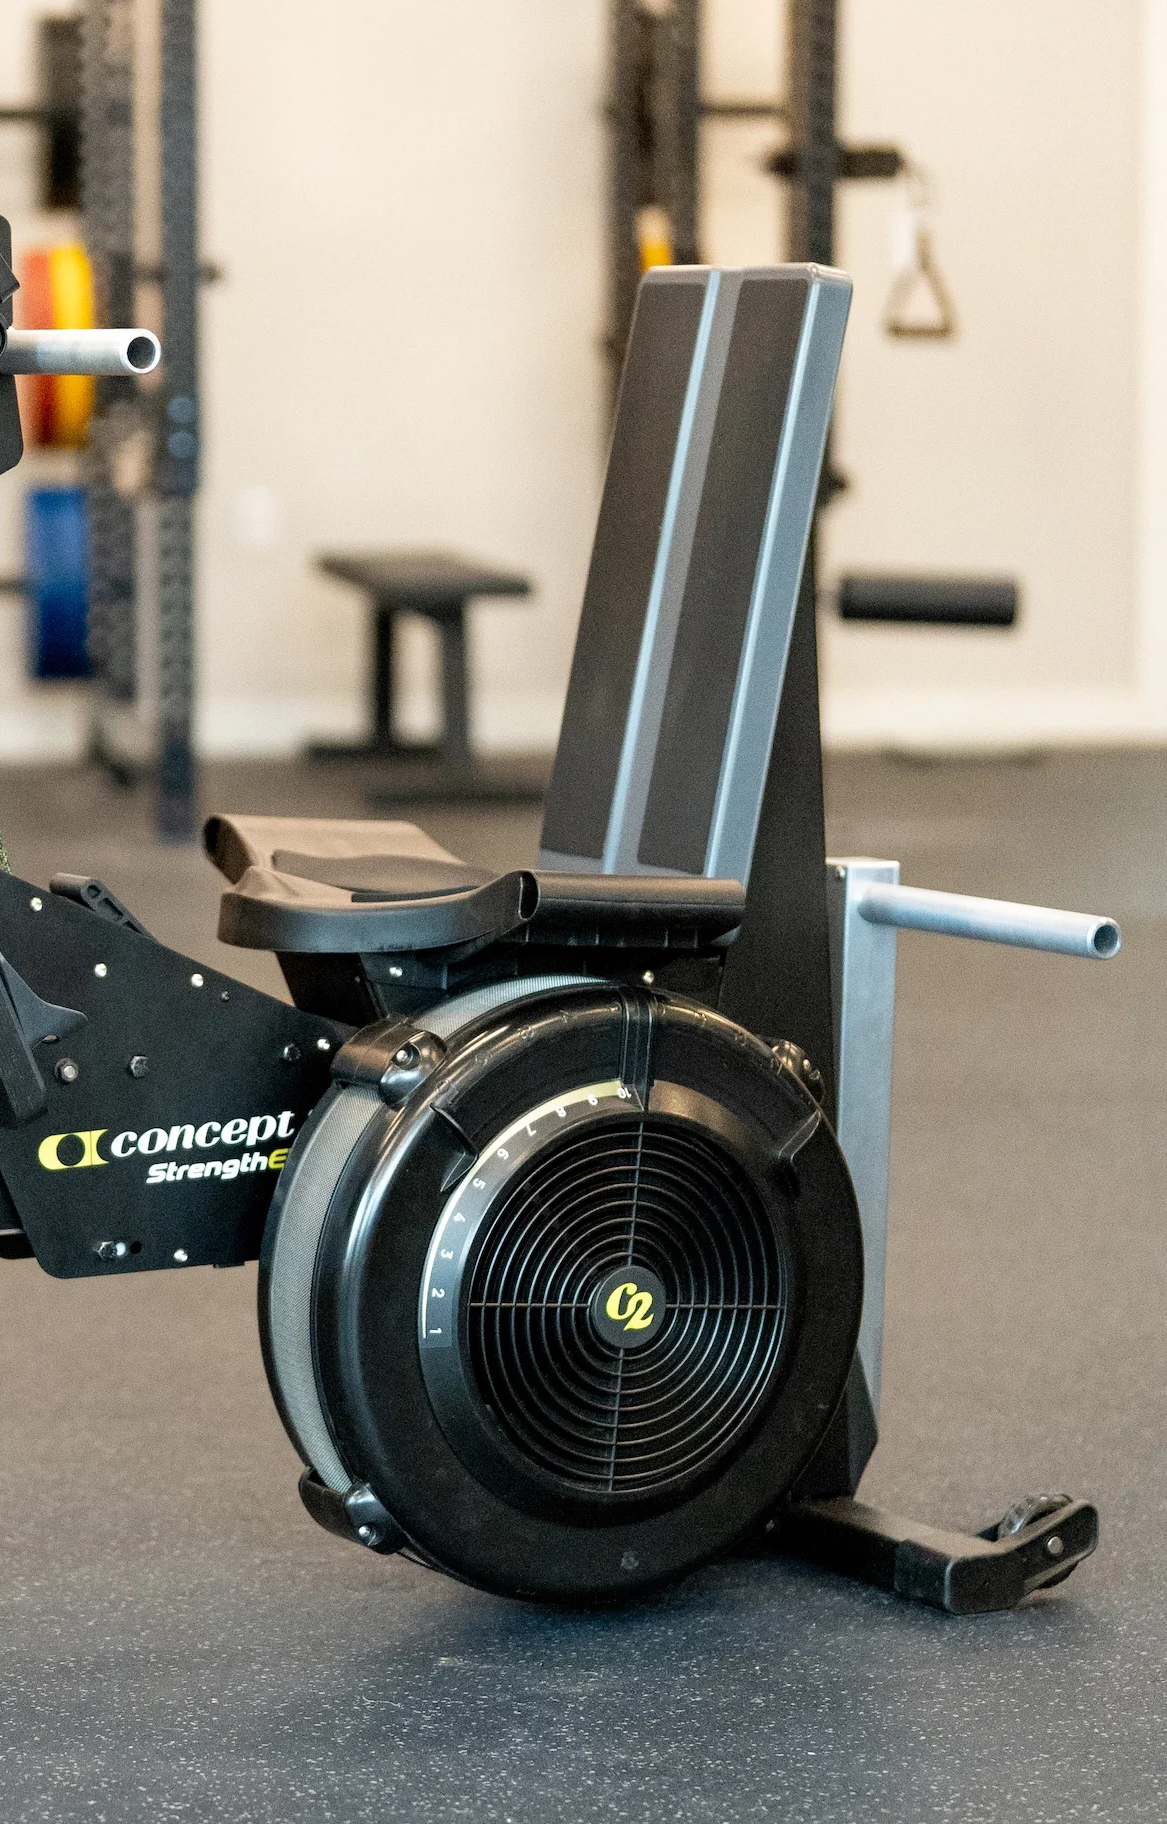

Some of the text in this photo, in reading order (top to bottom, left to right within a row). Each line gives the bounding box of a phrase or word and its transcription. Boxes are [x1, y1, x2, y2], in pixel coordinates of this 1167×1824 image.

[110, 1110, 295, 1158] concept
[431, 1287, 445, 1299] 2
[440, 1248, 454, 1260] 3
[453, 1211, 466, 1223] 4
[473, 1177, 486, 1190] 5
[496, 1148, 509, 1160] 6
[525, 1123, 537, 1136] 7
[555, 1105, 567, 1118] 8
[587, 1093, 599, 1106] 9
[617, 1087, 632, 1099] 10
[605, 1282, 654, 1331] C2
